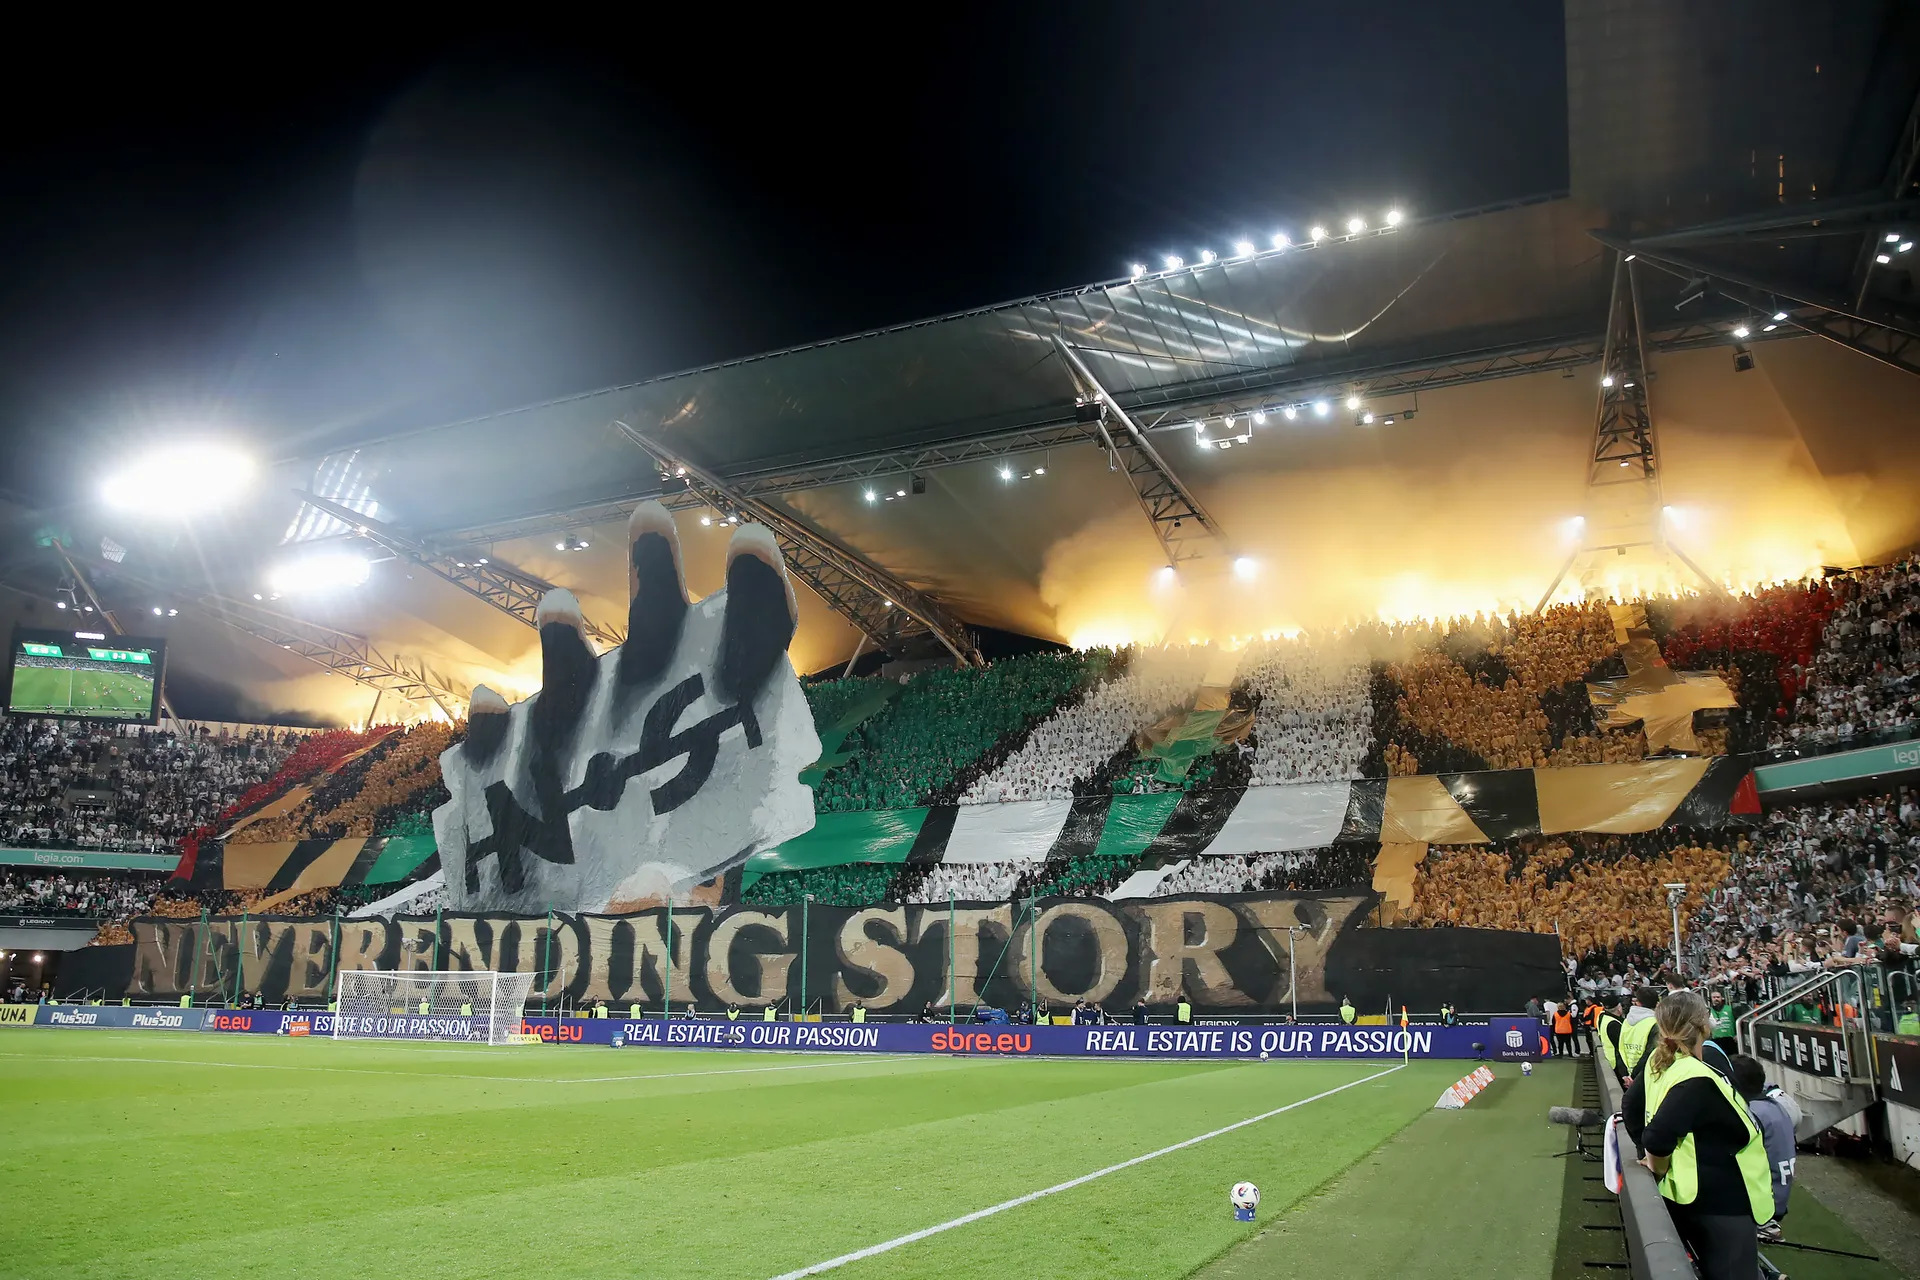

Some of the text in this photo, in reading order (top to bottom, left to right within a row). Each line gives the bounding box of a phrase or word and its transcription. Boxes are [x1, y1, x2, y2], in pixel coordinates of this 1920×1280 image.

[34, 852, 84, 864] legia.com
[26, 918, 56, 926] LEGIONY
[126, 897, 1369, 1011] NEVERENDING STORY
[0, 1008, 26, 1022] UNA
[51, 1011, 97, 1025] Plus500
[132, 1013, 183, 1027] Plus500
[360, 1017, 374, 1033] IS
[377, 1017, 405, 1035] OUR
[410, 1018, 471, 1036] PASSION
[624, 1023, 879, 1047] REAL ESTATE IS OUR PASSION
[931, 1026, 1031, 1052] sbre.eu
[1086, 1030, 1432, 1053] REAL ESTATE IS OUR PASSION
